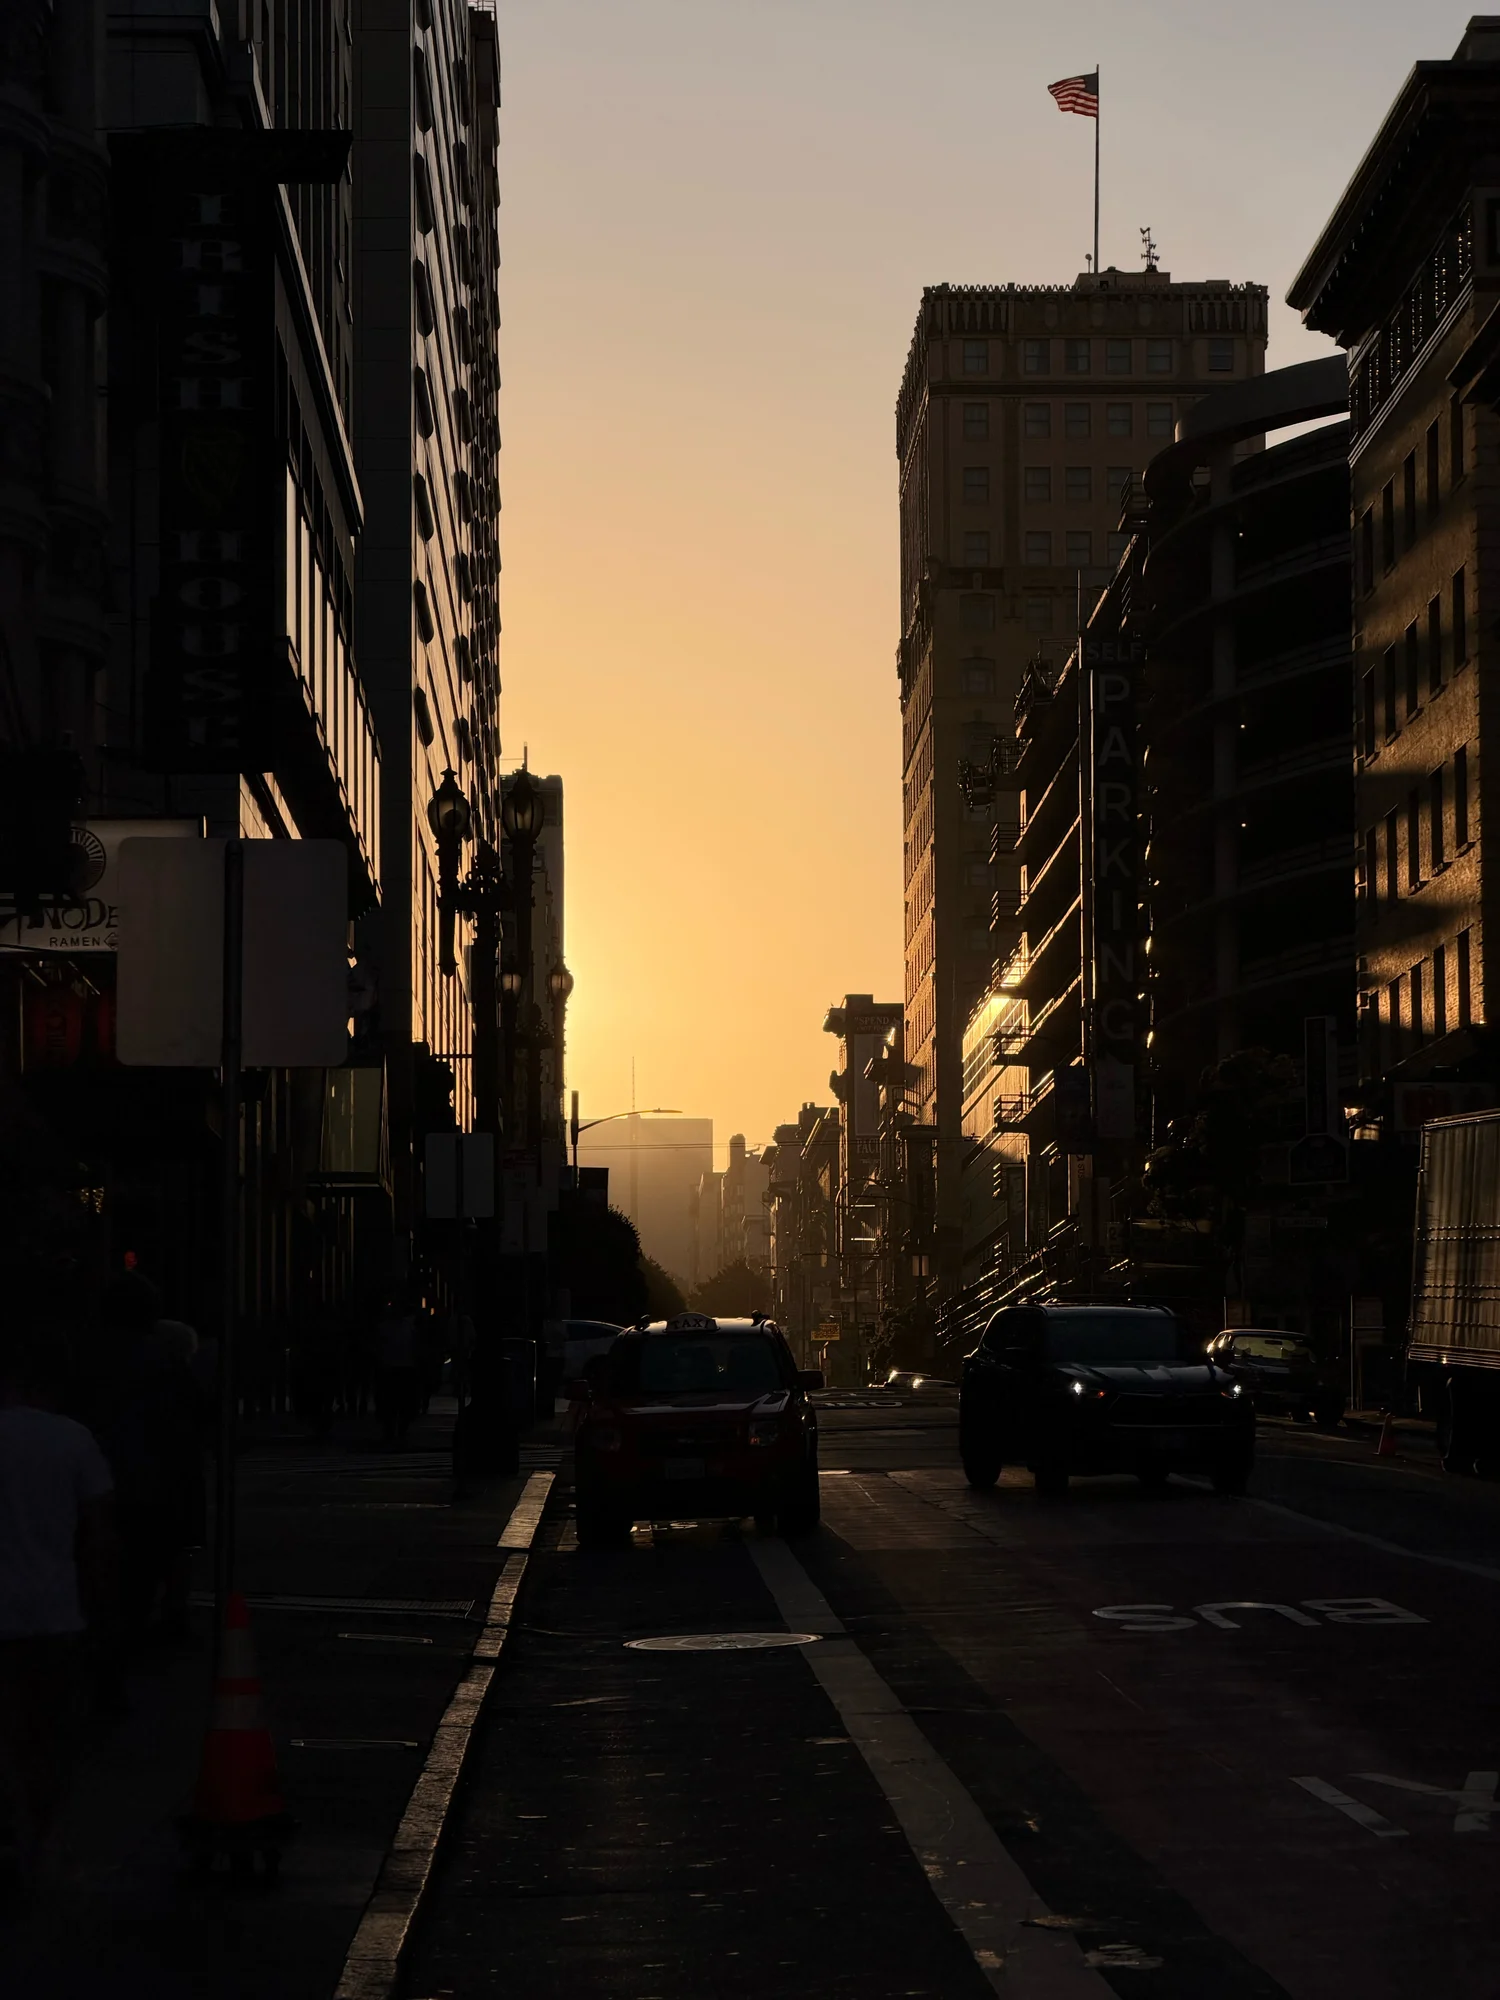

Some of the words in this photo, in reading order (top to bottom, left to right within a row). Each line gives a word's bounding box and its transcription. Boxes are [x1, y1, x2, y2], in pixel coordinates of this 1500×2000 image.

[169, 191, 253, 411] IRISH
[171, 529, 246, 749] HOUSE
[1086, 641, 1143, 663] SELF
[1098, 673, 1135, 1040] PARKING
[49, 936, 101, 948] RAMEN
[670, 1318, 710, 1330] TAXI
[1091, 1597, 1431, 1632] BUS
